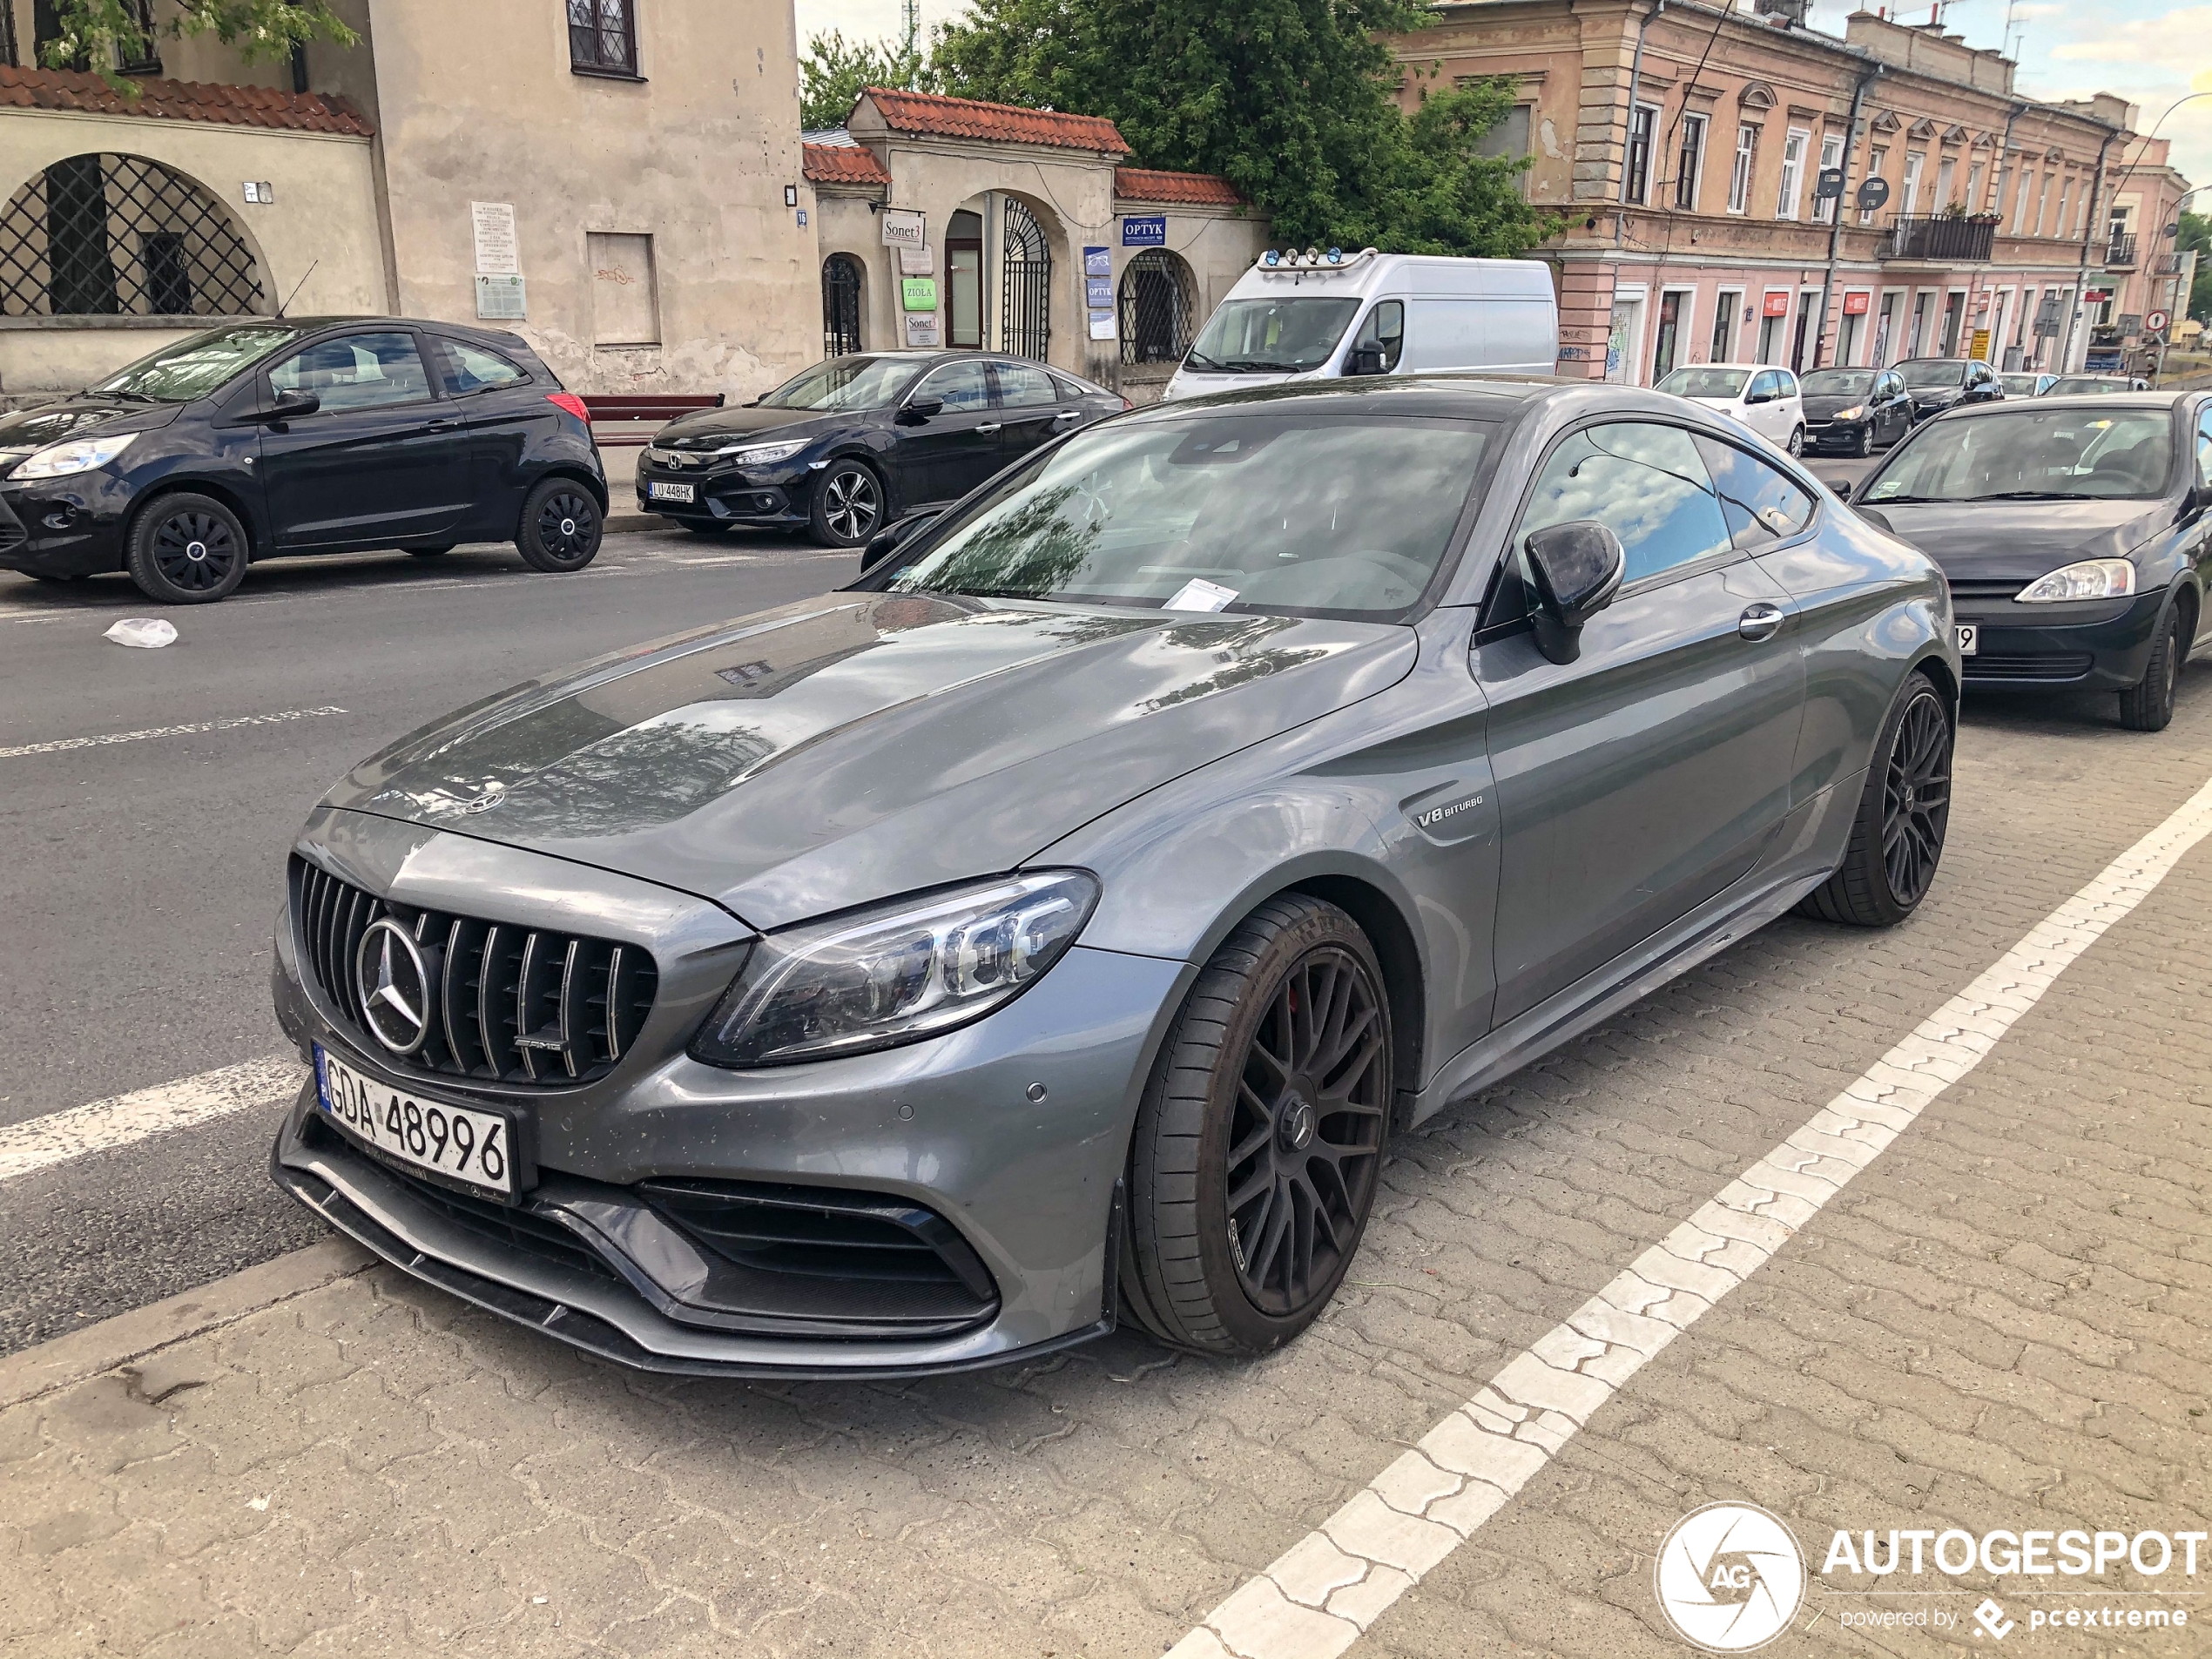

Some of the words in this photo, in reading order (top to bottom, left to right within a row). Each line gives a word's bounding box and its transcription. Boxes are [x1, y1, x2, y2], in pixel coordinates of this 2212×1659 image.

[799, 213, 806, 223] 16
[886, 221, 920, 238] Sonet3
[1125, 224, 1163, 235] OPTYK
[909, 317, 935, 328] Sonet3
[653, 483, 664, 496] LU
[666, 485, 691, 499] 448HK
[1418, 808, 1442, 827] V8
[1445, 796, 1482, 818] BITURBO
[529, 1041, 561, 1050] AMG
[328, 1059, 376, 1137] GDA
[386, 1095, 504, 1181] 48996
